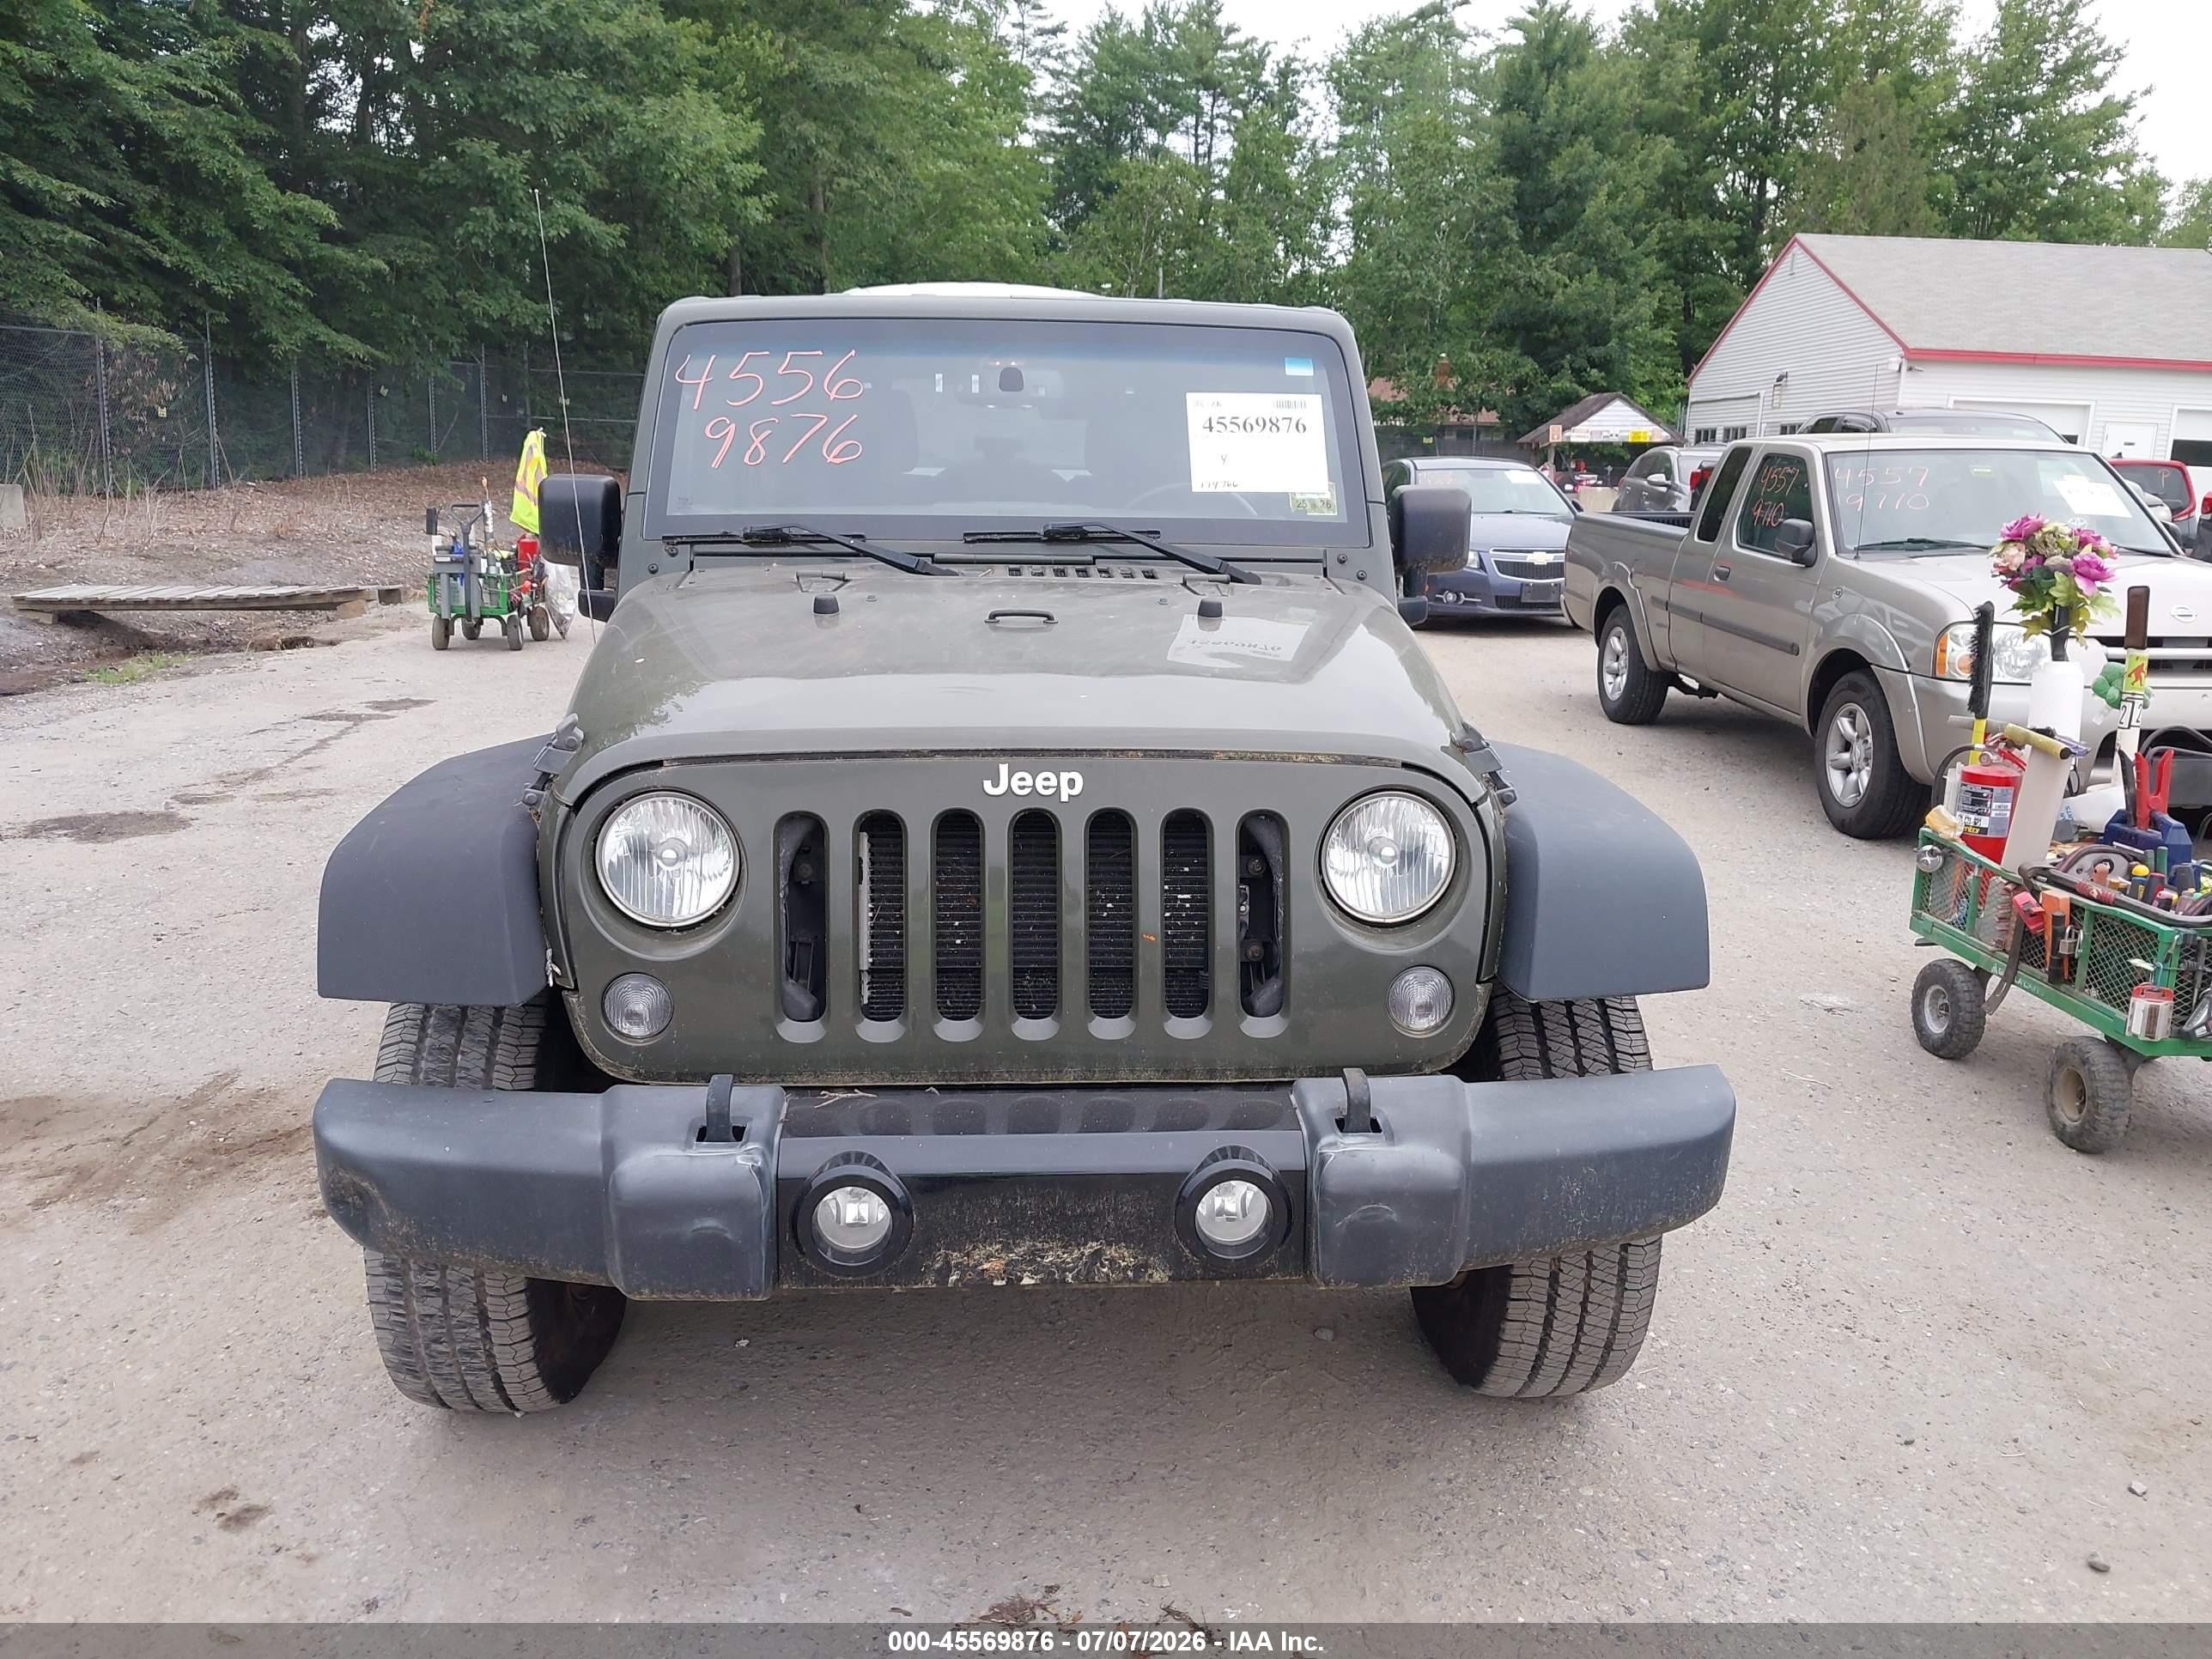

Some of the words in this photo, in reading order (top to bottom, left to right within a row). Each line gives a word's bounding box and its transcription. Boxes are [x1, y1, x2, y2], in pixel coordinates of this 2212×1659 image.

[675, 349, 864, 410] 4556
[704, 413, 863, 468] 9876
[1202, 416, 1307, 434] 45569876
[1761, 465, 1800, 495] 4557
[1834, 466, 1929, 488] 4557
[982, 763, 1085, 803] Jeep
